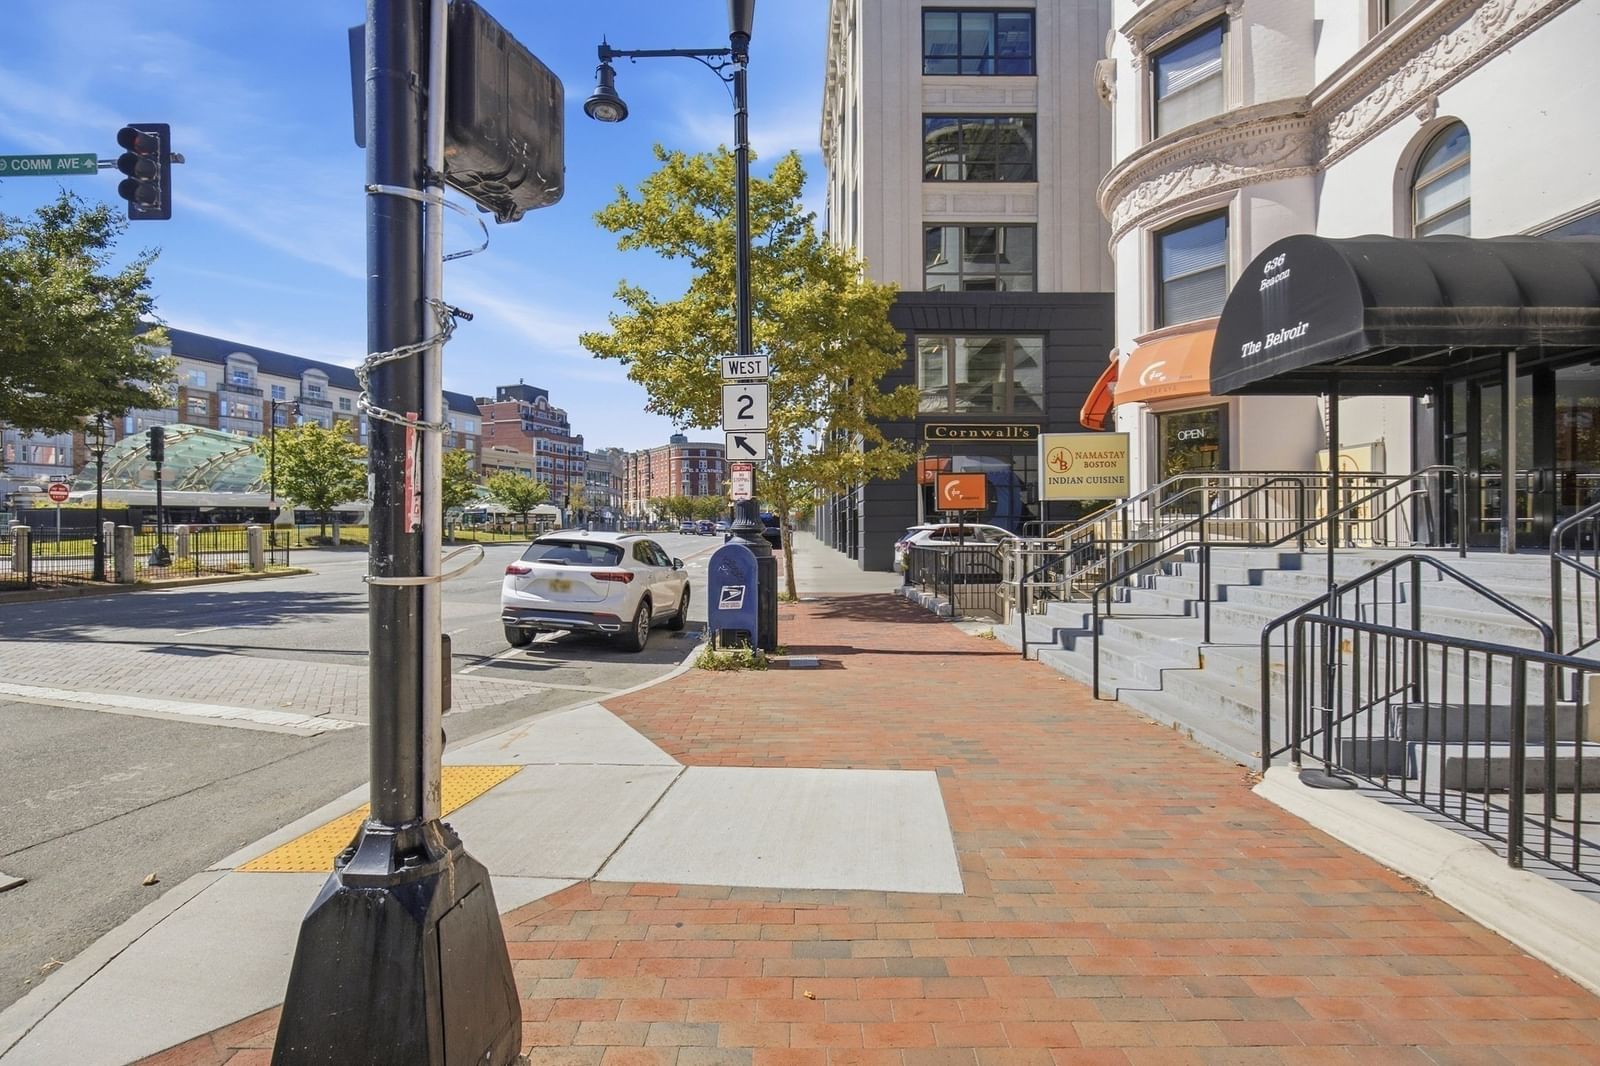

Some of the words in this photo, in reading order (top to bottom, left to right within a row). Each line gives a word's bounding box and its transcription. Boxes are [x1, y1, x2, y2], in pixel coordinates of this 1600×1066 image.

[11, 158, 52, 171] COMM
[57, 157, 80, 169] AVE
[1263, 252, 1287, 274] 636
[1259, 268, 1291, 292] Beacon
[1241, 340, 1263, 359] The
[1264, 321, 1310, 350] Belvoir
[728, 360, 762, 375] WEST
[736, 394, 755, 420] 2
[935, 426, 1030, 438] Cornwall's
[1177, 427, 1205, 441] OPEN
[1075, 450, 1126, 460] NAMASTAY
[1083, 460, 1117, 469] BOSTON
[1048, 476, 1083, 485] INDIAN
[1086, 475, 1125, 484] CUISINE
